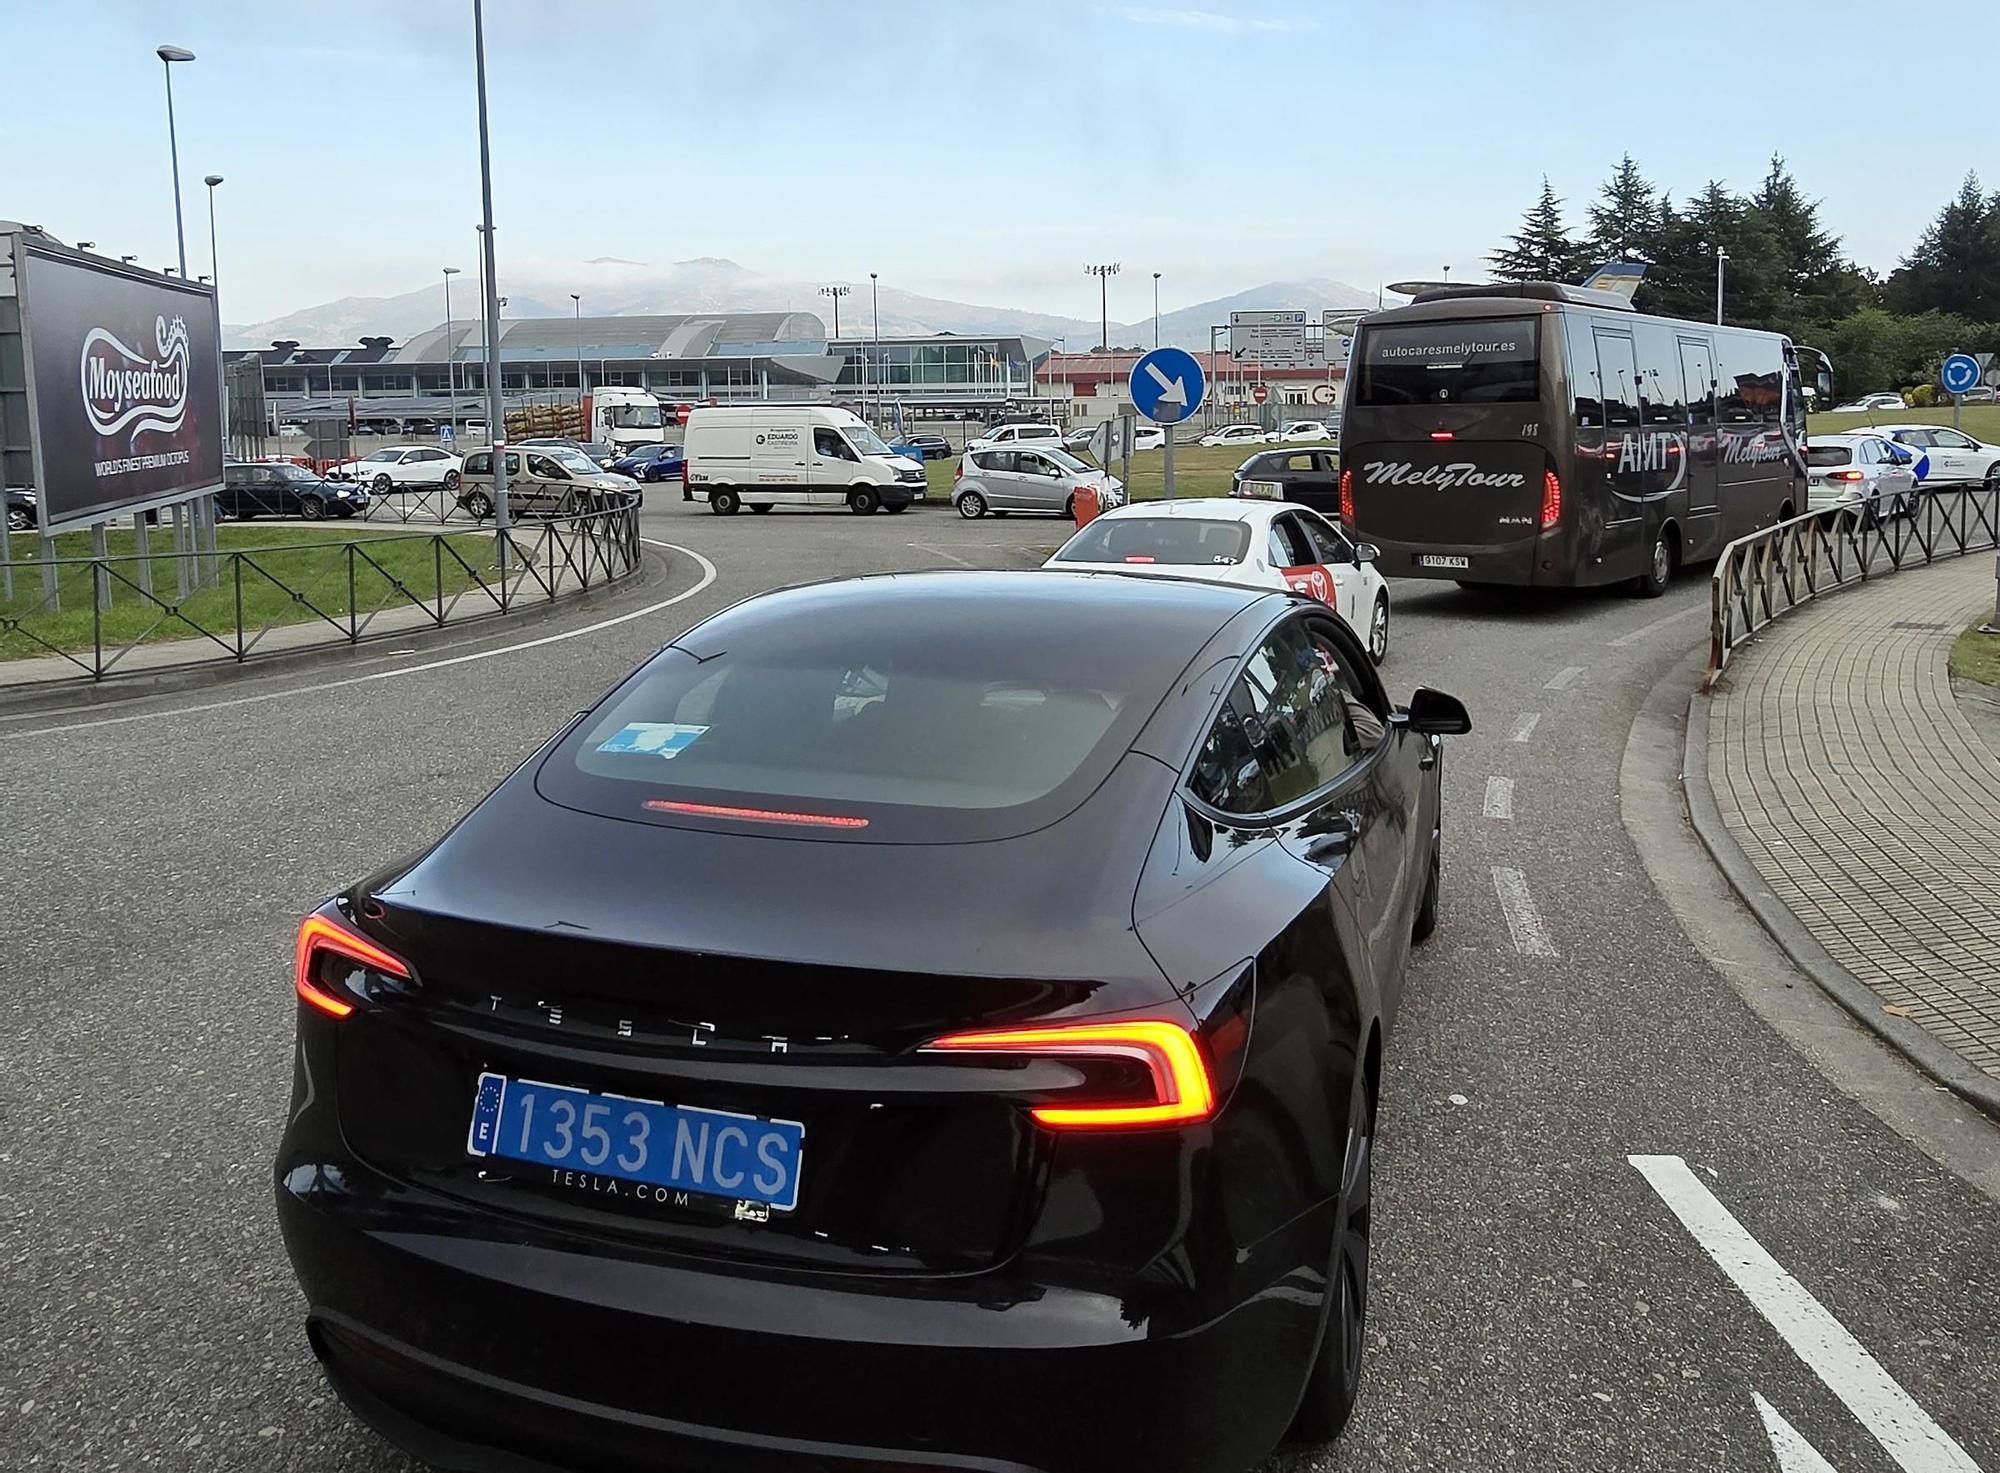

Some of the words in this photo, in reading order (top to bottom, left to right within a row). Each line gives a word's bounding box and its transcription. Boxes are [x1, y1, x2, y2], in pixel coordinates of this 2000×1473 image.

[1382, 341, 1516, 358] autocaresmelytour.es
[89, 356, 181, 412] Moyseafood
[1618, 431, 1671, 474] AMT
[1253, 483, 1273, 496] TAXI
[1363, 461, 1525, 491] MelyTour
[1425, 556, 1447, 566] 9107
[490, 995, 789, 1054] TESLA
[478, 1122, 490, 1141] E
[518, 1093, 651, 1173] 1353
[670, 1117, 789, 1196] NCS
[552, 1168, 690, 1207] TESLA.COM
